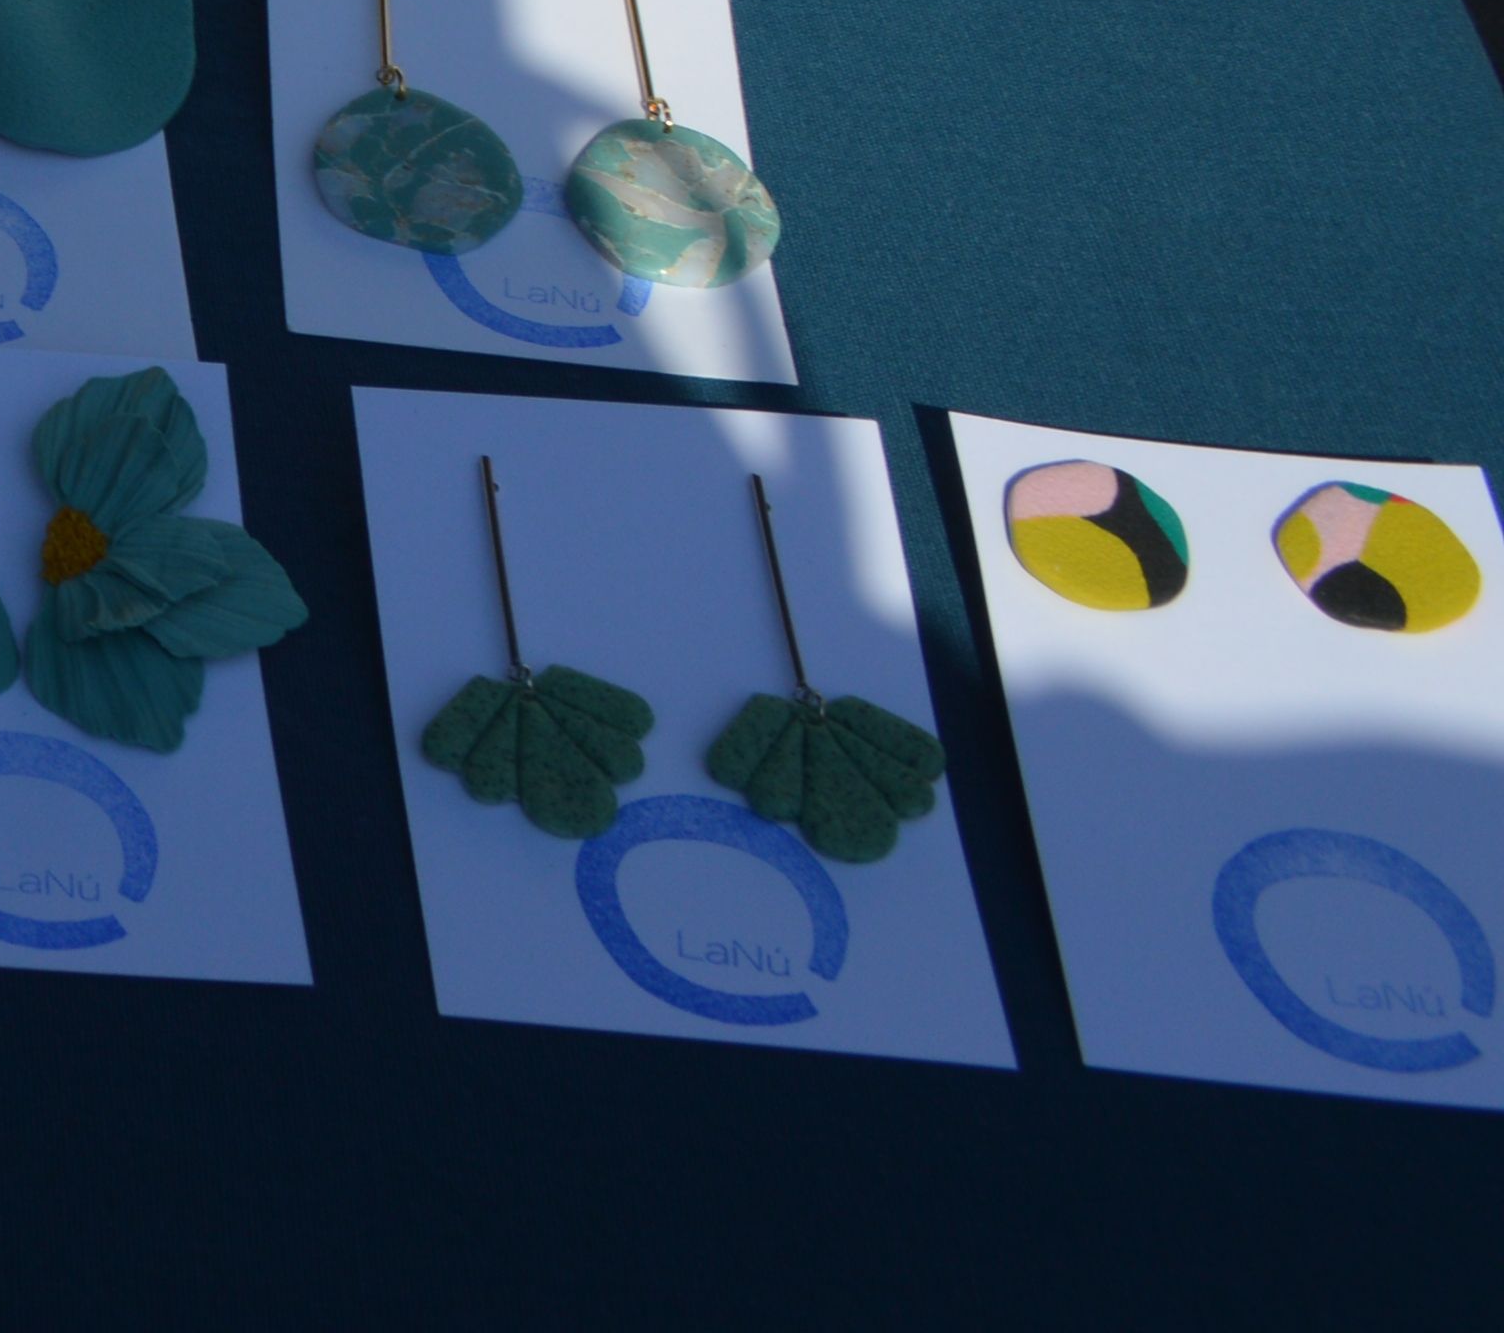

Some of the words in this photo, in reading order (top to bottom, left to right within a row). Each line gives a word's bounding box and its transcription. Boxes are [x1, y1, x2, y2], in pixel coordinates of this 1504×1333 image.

[503, 278, 600, 313] LaNú
[678, 930, 790, 976] LaNú
[1327, 977, 1444, 1017] LaNú
